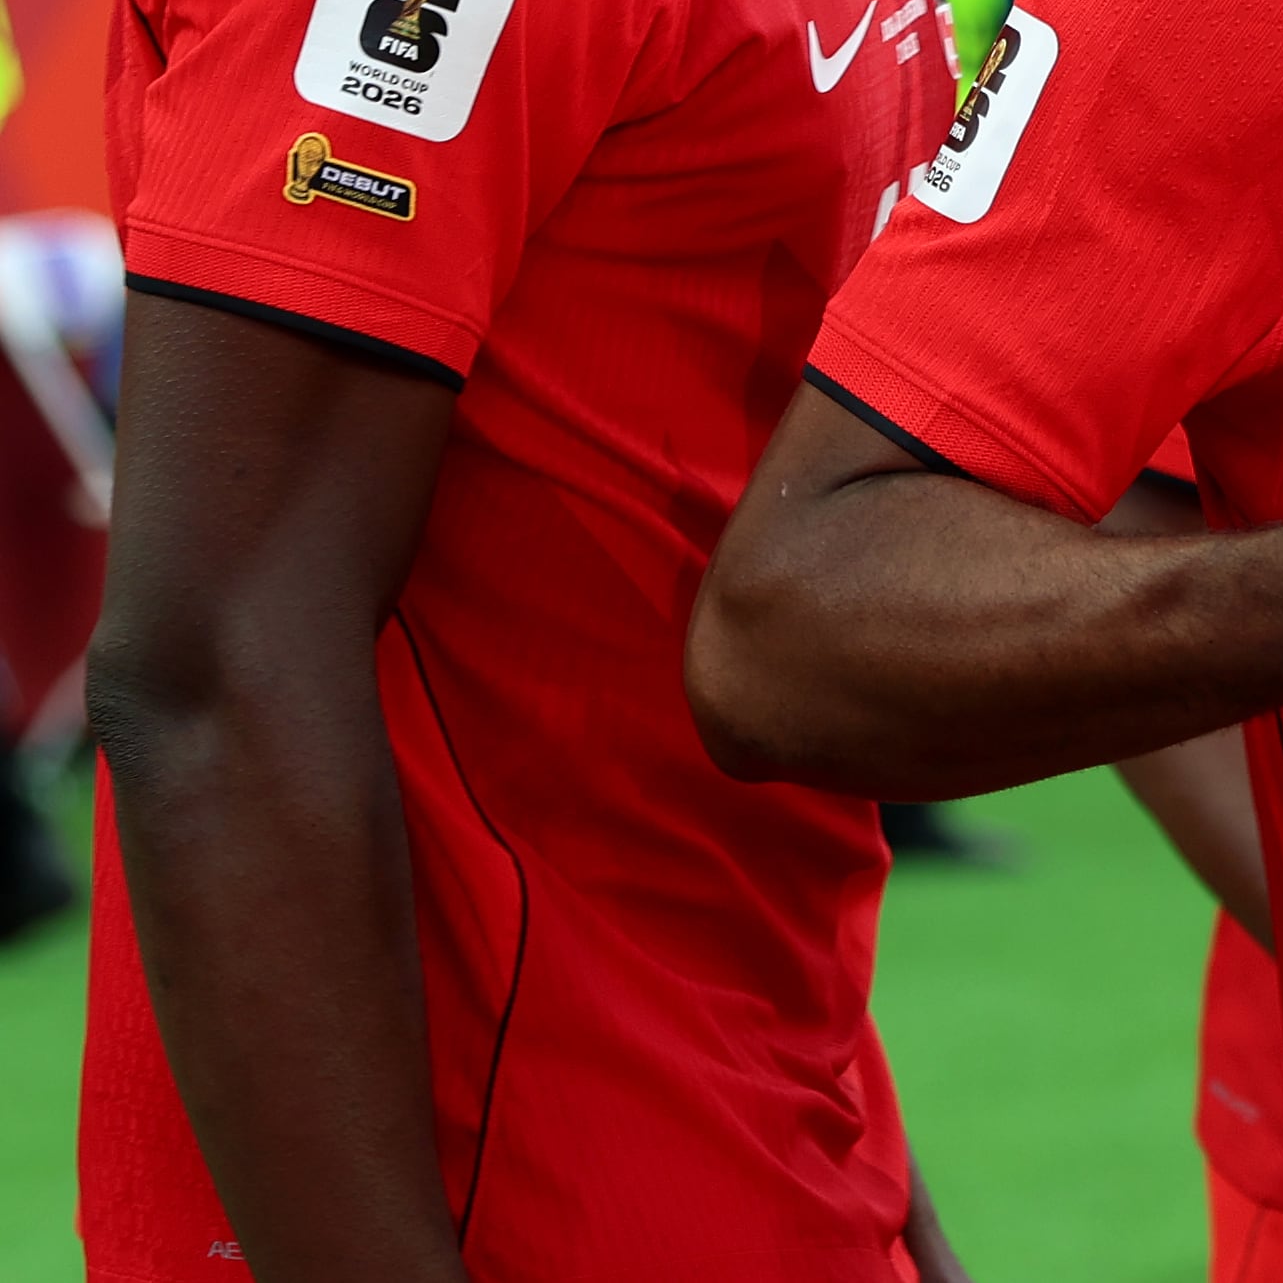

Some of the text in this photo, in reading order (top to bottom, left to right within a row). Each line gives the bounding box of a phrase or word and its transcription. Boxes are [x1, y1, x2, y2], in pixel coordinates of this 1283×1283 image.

[378, 36, 419, 61] FIFA
[349, 60, 430, 94] WORLD CUP
[341, 76, 422, 115] 2026
[946, 158, 961, 173] CUP
[320, 166, 407, 200] DEBUT
